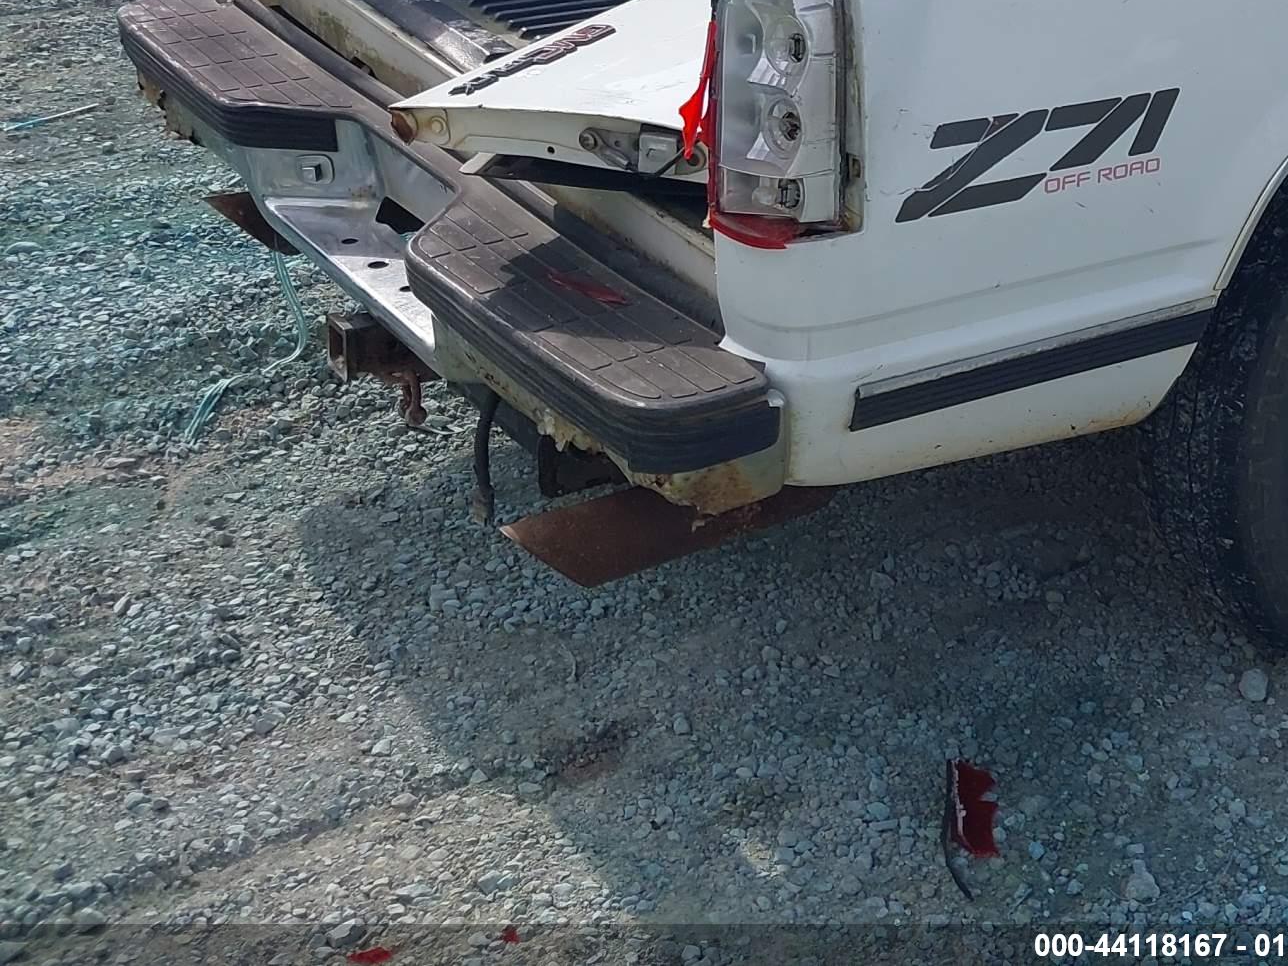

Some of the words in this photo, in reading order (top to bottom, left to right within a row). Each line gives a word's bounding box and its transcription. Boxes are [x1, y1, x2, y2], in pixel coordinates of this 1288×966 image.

[895, 87, 1180, 224] Z71
[1044, 171, 1092, 194] OFF
[1097, 157, 1161, 184] ROAD
